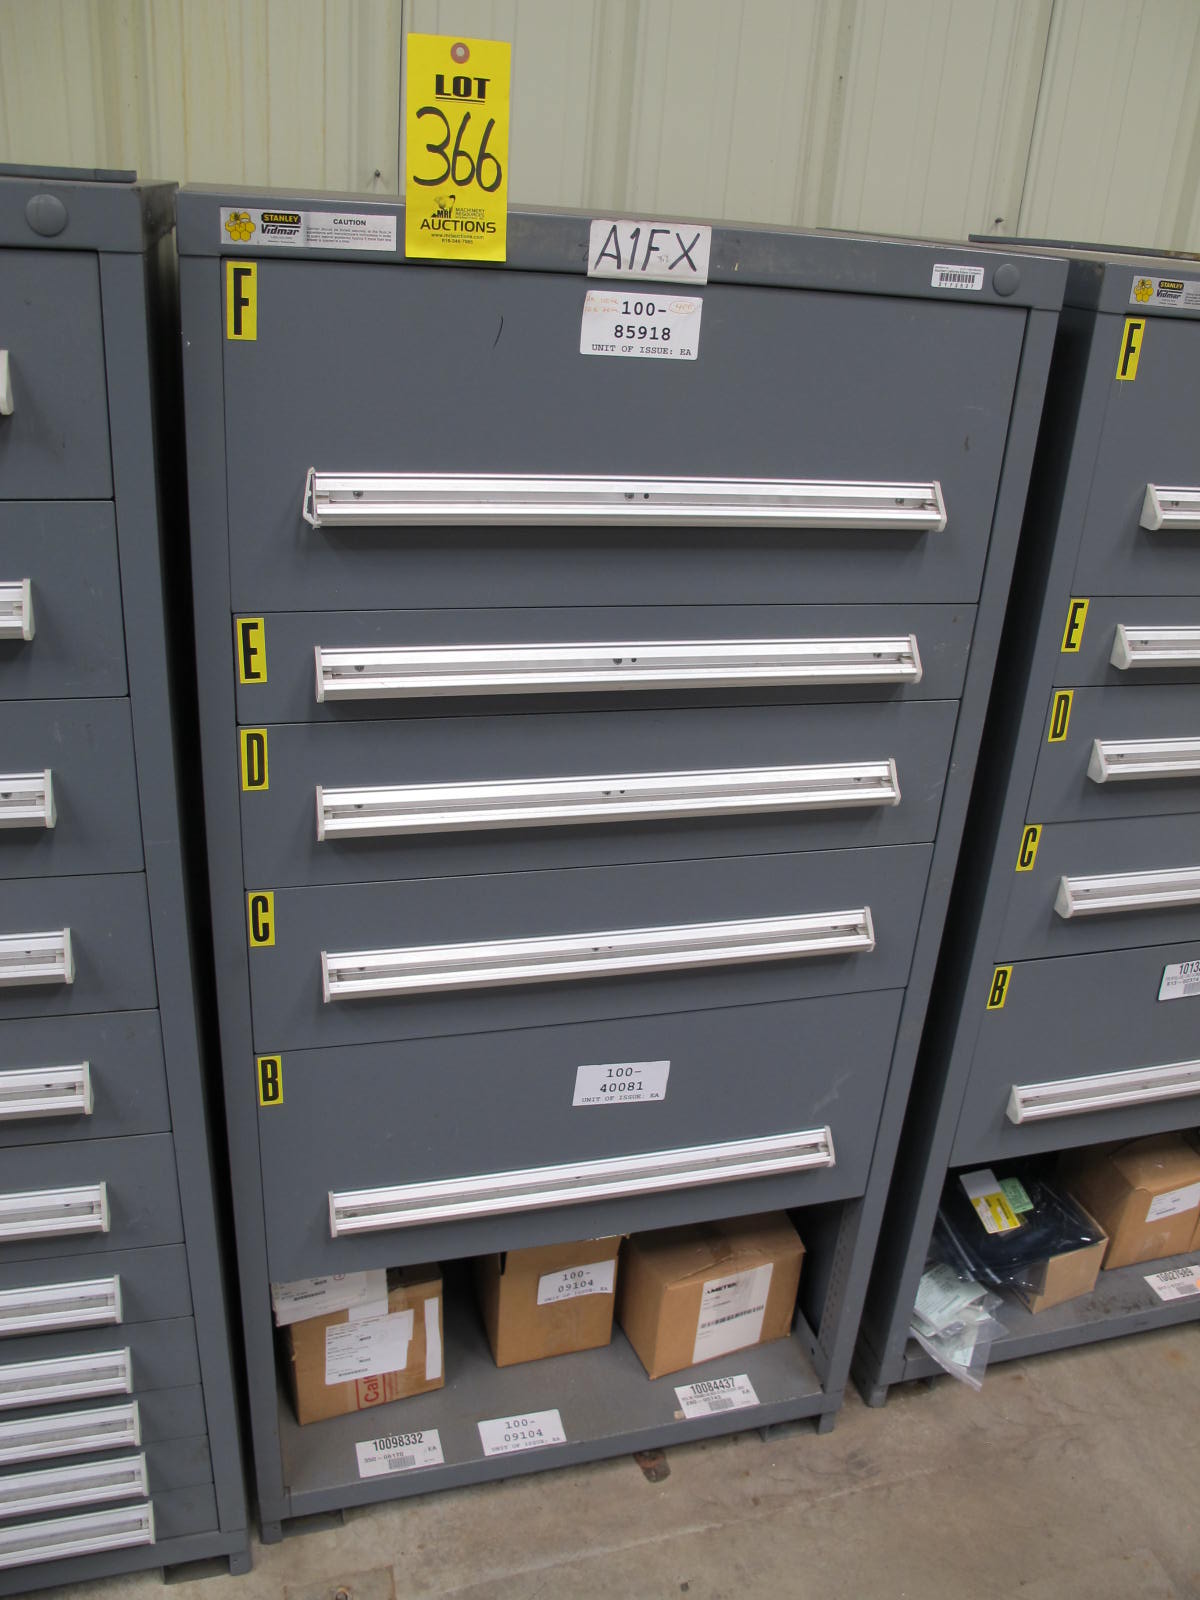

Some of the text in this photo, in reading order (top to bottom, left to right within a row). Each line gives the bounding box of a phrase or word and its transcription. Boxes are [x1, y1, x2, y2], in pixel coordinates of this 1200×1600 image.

[435, 74, 491, 99] LOT
[413, 105, 502, 192] 366
[263, 214, 299, 223] STANLEY
[333, 218, 367, 227] CAUTION
[420, 218, 496, 233] AUCTIONS
[261, 223, 300, 235] Vidmar
[593, 224, 701, 272] A1FX
[1156, 288, 1182, 299] Vidmar
[1160, 281, 1183, 289] STANLEY
[232, 267, 252, 336] F
[621, 301, 667, 316] 100-
[614, 324, 671, 341] 85918
[592, 343, 692, 356] UNIT OF ISSUE: EA
[1120, 322, 1142, 377] F
[1064, 602, 1085, 649] E
[241, 622, 261, 680] E
[1051, 694, 1070, 739] D
[246, 733, 266, 787] D
[1019, 827, 1038, 868] C
[251, 895, 270, 942] C
[1179, 961, 1200, 976] 1013
[988, 969, 1008, 1007] B
[260, 1059, 279, 1102] B
[606, 1067, 642, 1078] 100-
[599, 1081, 643, 1093] 40081
[563, 1270, 591, 1281] 100-
[557, 1279, 593, 1293] 09104
[690, 1377, 736, 1395] 10084437
[505, 1418, 535, 1429] 100-
[372, 1432, 424, 1451] 10098332
[504, 1428, 544, 1442] 09104
